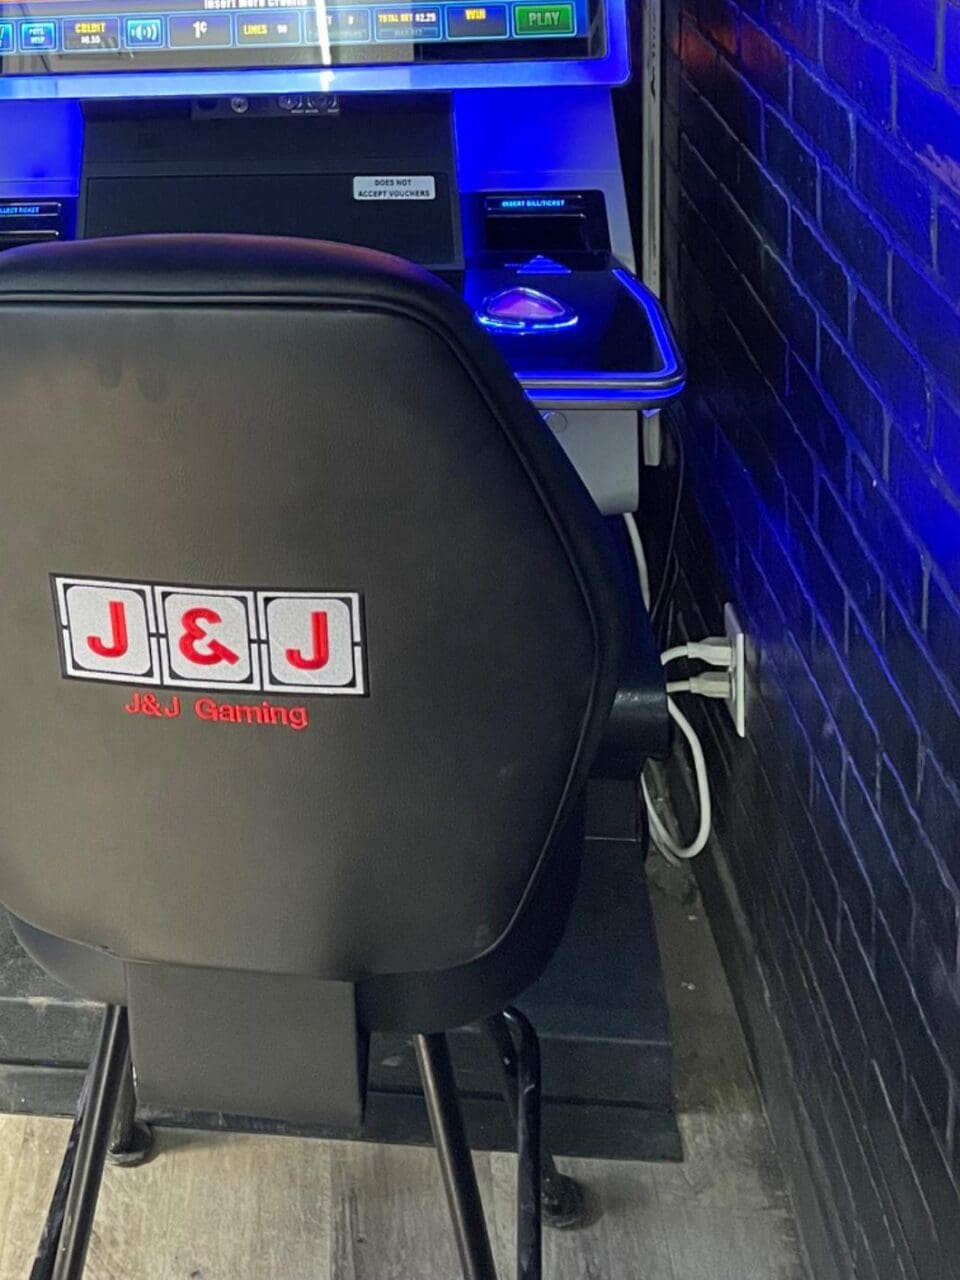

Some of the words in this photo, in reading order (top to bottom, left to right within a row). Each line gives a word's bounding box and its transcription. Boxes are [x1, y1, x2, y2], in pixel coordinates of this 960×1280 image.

[528, 11, 560, 26] PLAY
[124, 692, 181, 718] J&J
[195, 697, 309, 730] Gaming
